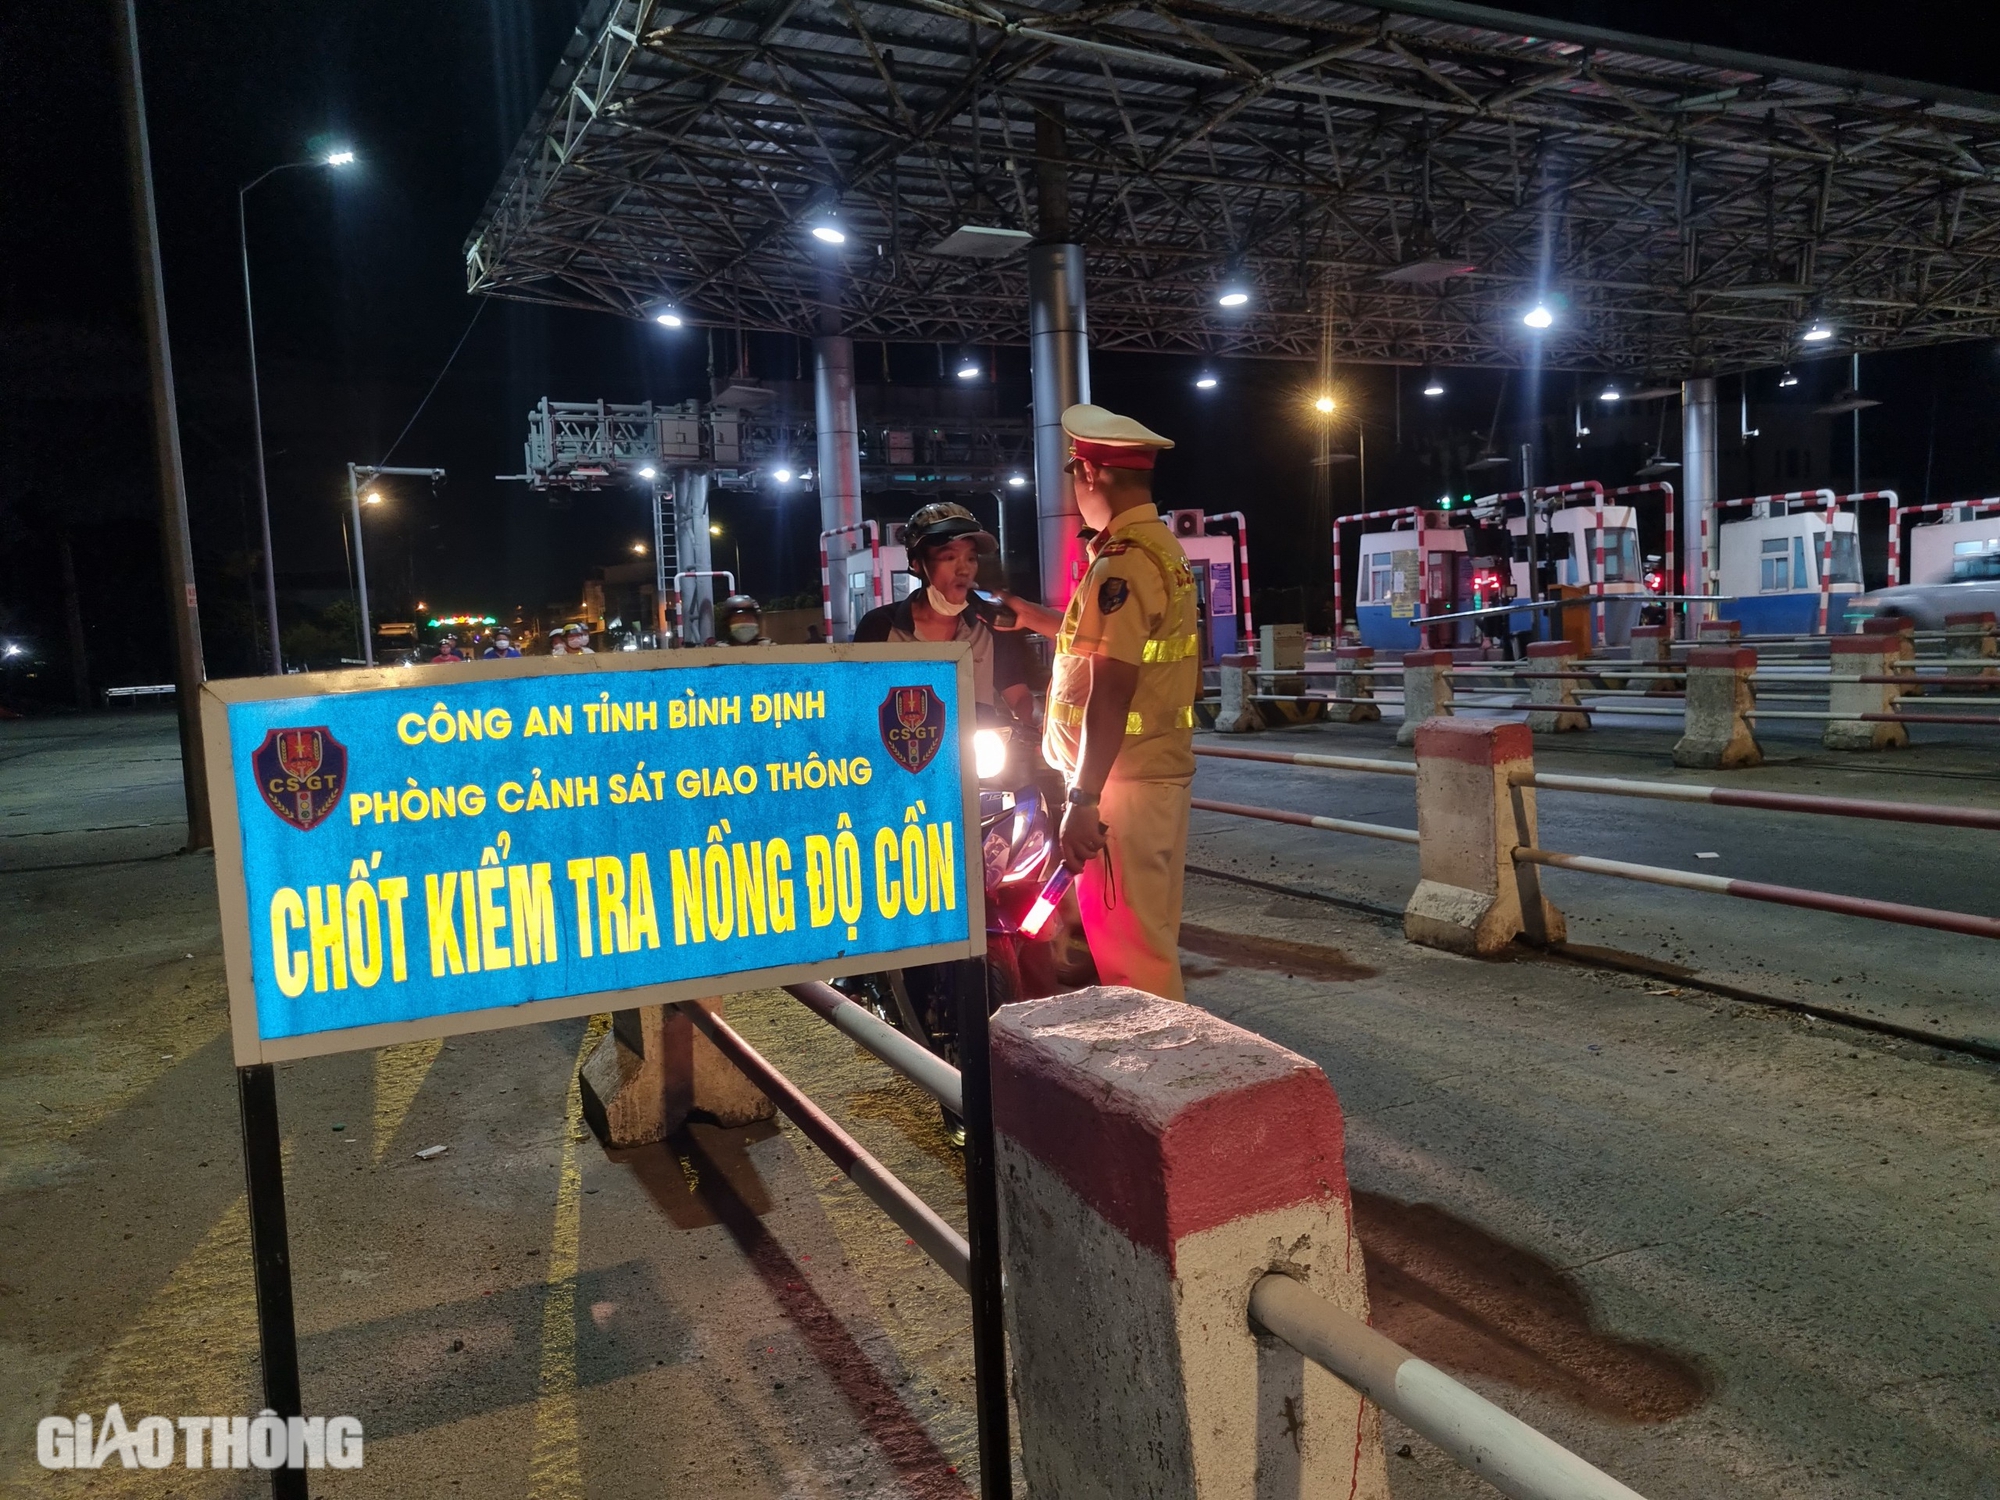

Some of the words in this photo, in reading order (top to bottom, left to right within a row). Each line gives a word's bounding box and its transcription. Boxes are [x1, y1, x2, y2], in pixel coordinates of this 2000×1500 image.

[397, 702, 513, 745] CÔNG
[524, 704, 573, 737] AN
[583, 692, 658, 733] TỈNH
[669, 688, 741, 729] BÌNH
[751, 690, 825, 729] ĐỊNH
[350, 777, 487, 826] PHÒNG
[497, 767, 599, 813] CẢNH
[608, 761, 666, 804] SÁT
[676, 765, 758, 799] GIAO
[766, 751, 873, 792] THÔNG
[270, 851, 409, 997] CHỐT
[424, 830, 558, 978] KIỂM
[567, 852, 661, 958] TRA
[669, 818, 796, 946] NỒNG
[805, 812, 863, 941] ĐỘ
[874, 800, 956, 920] CỒN
